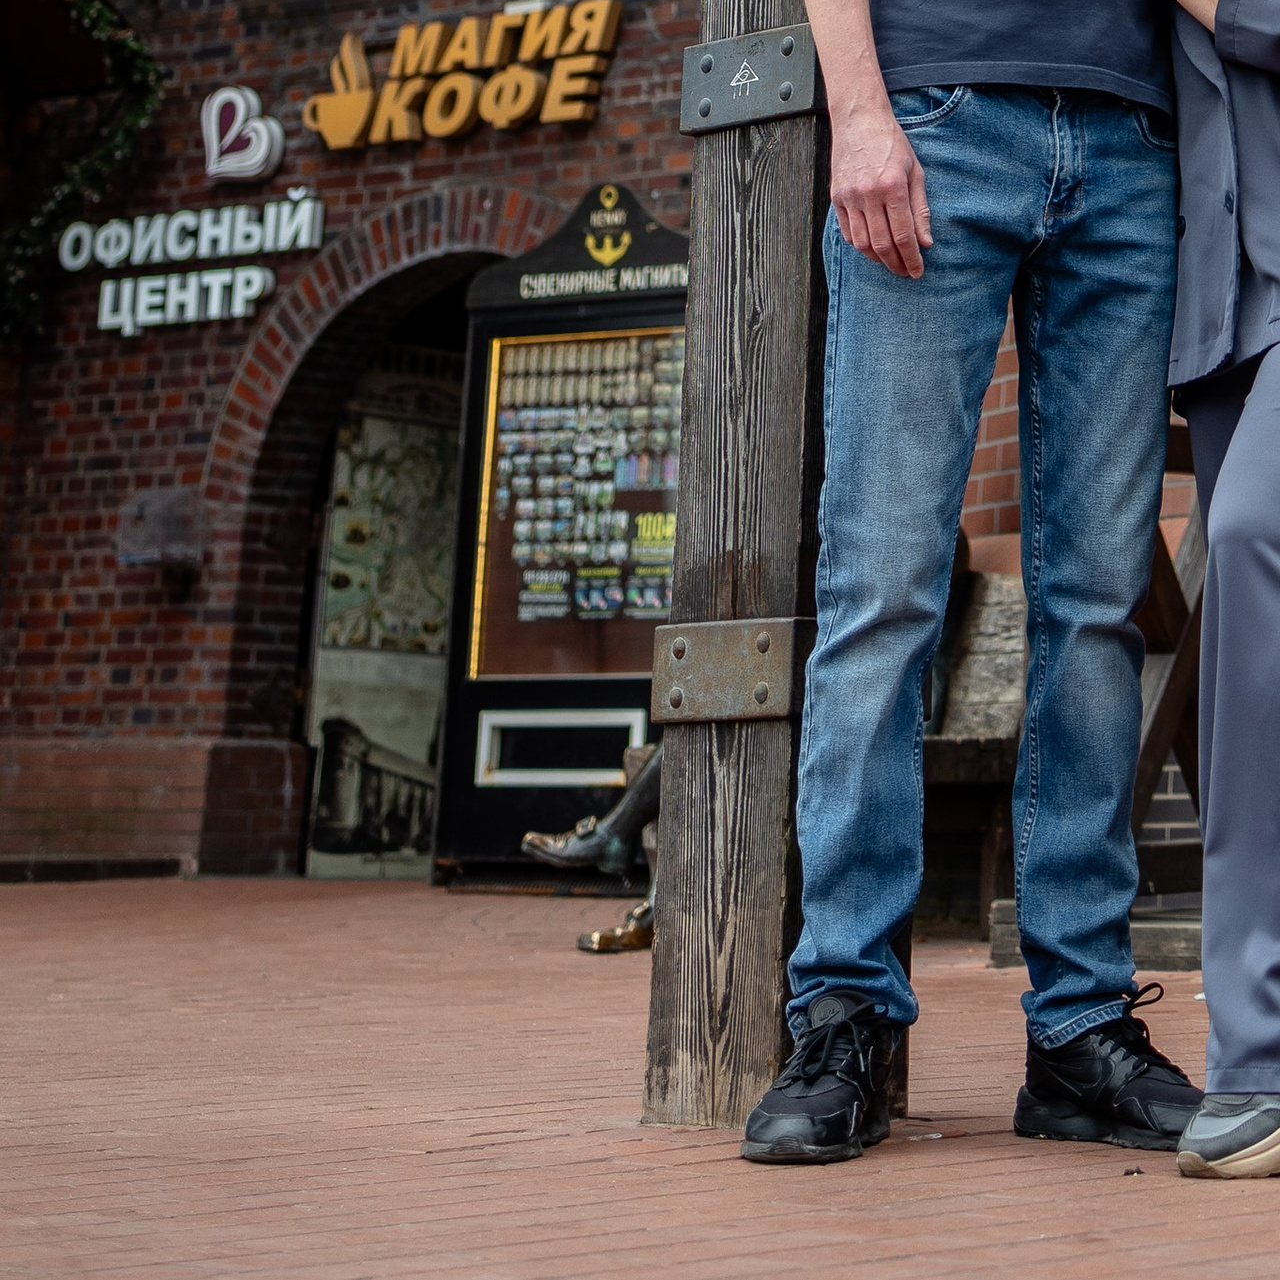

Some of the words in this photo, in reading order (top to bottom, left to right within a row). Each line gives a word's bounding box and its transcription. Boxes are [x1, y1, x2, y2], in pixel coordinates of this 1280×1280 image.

[368, 53, 606, 145] КОФЕ
[58, 185, 323, 272] ОФИСНЫЙ
[97, 265, 275, 337] ЦЕНТР
[520, 268, 618, 299] СУВЕНИРНЫЕ
